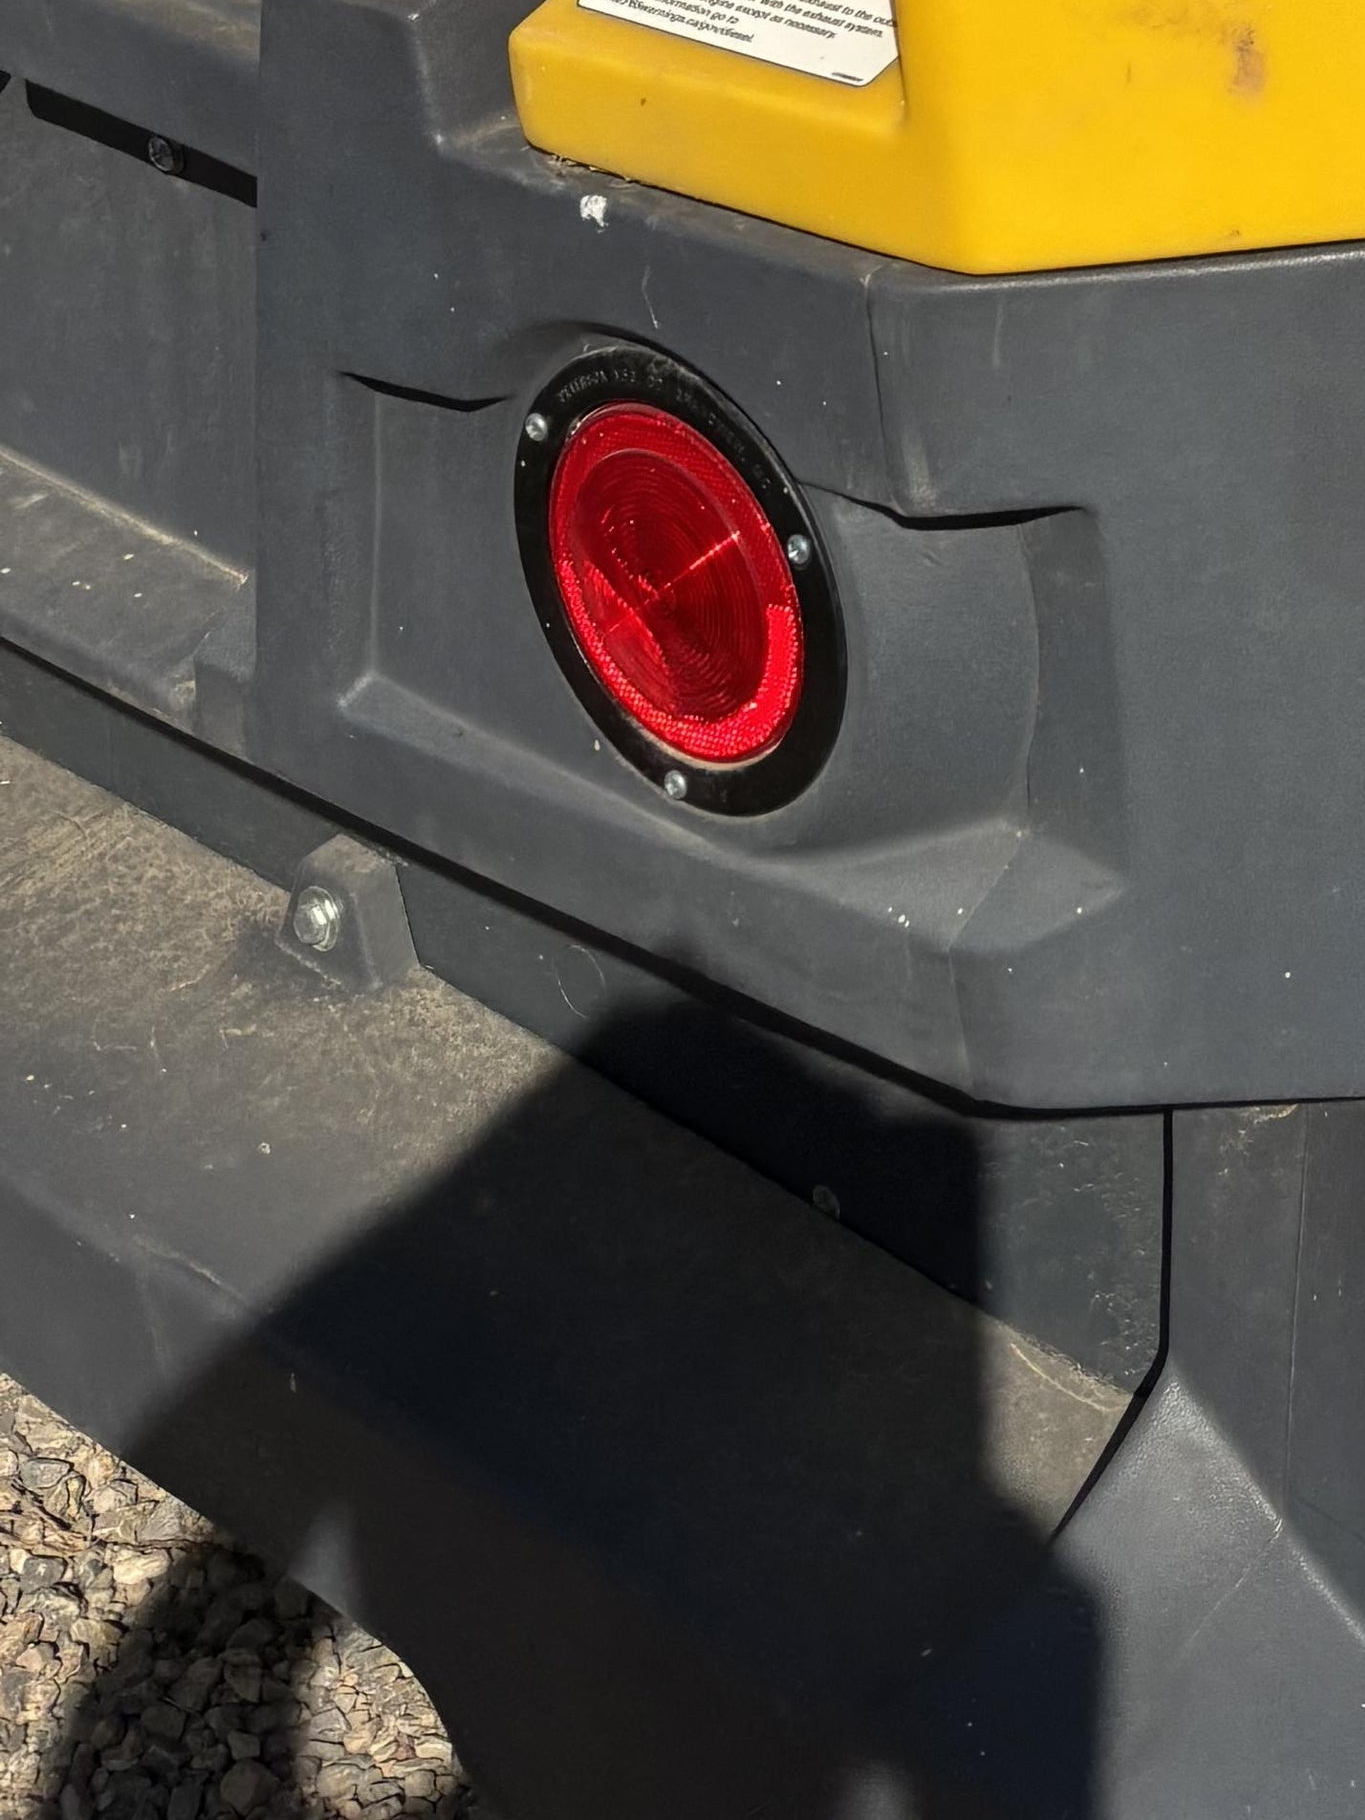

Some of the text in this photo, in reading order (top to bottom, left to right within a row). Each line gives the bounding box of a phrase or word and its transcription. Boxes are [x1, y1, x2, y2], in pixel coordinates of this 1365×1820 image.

[710, 12, 726, 20] go
[726, 16, 739, 24] to
[735, 5, 769, 19] except
[769, 15, 783, 23] as
[784, 4, 802, 14] the
[803, 11, 845, 26] exhaust
[841, 6, 853, 15] to
[854, 10, 872, 20] the
